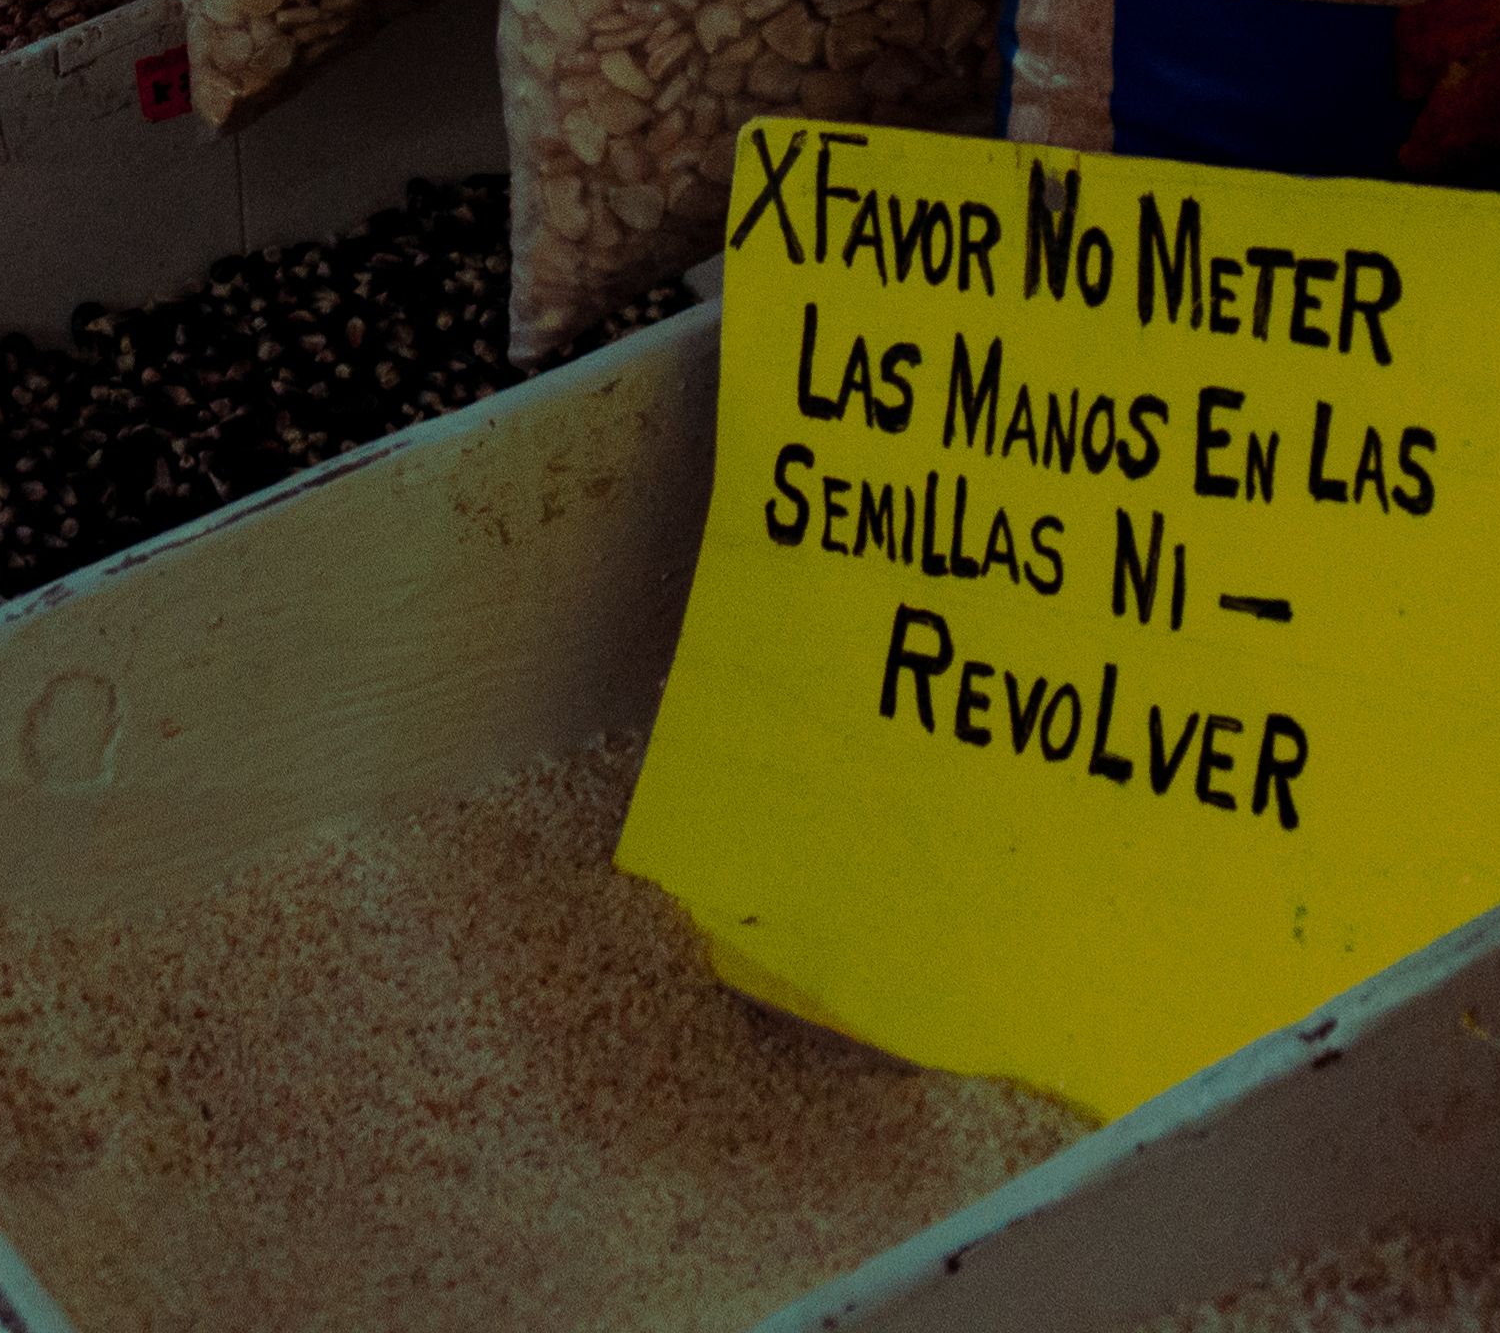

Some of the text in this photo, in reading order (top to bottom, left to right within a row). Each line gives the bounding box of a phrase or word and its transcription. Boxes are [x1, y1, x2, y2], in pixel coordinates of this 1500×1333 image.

[1136, 191, 1404, 369] METER
[798, 300, 924, 436] LAS
[942, 331, 1171, 482] MANOS
[1308, 399, 1438, 517] LAS
[765, 443, 1068, 597] SEMILLAS
[879, 603, 1309, 833] REVOLVER
